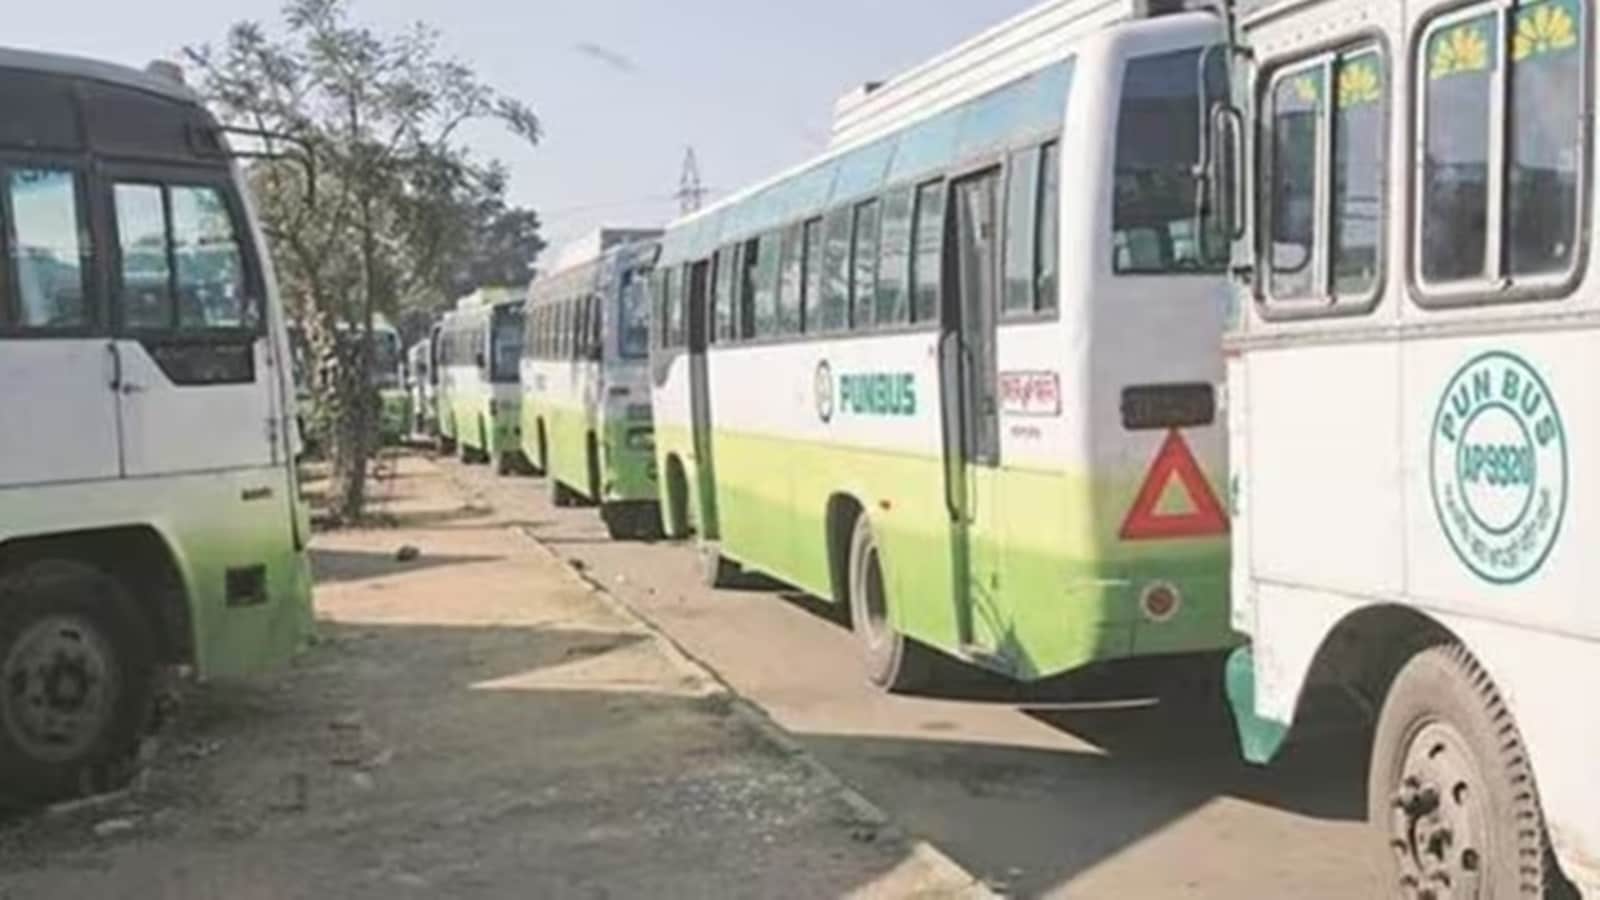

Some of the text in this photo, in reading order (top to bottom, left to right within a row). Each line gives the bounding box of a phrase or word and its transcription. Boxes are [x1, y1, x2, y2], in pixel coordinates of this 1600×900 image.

[839, 372, 917, 416] PUNBUS
[1441, 368, 1557, 447] PUN BUS
